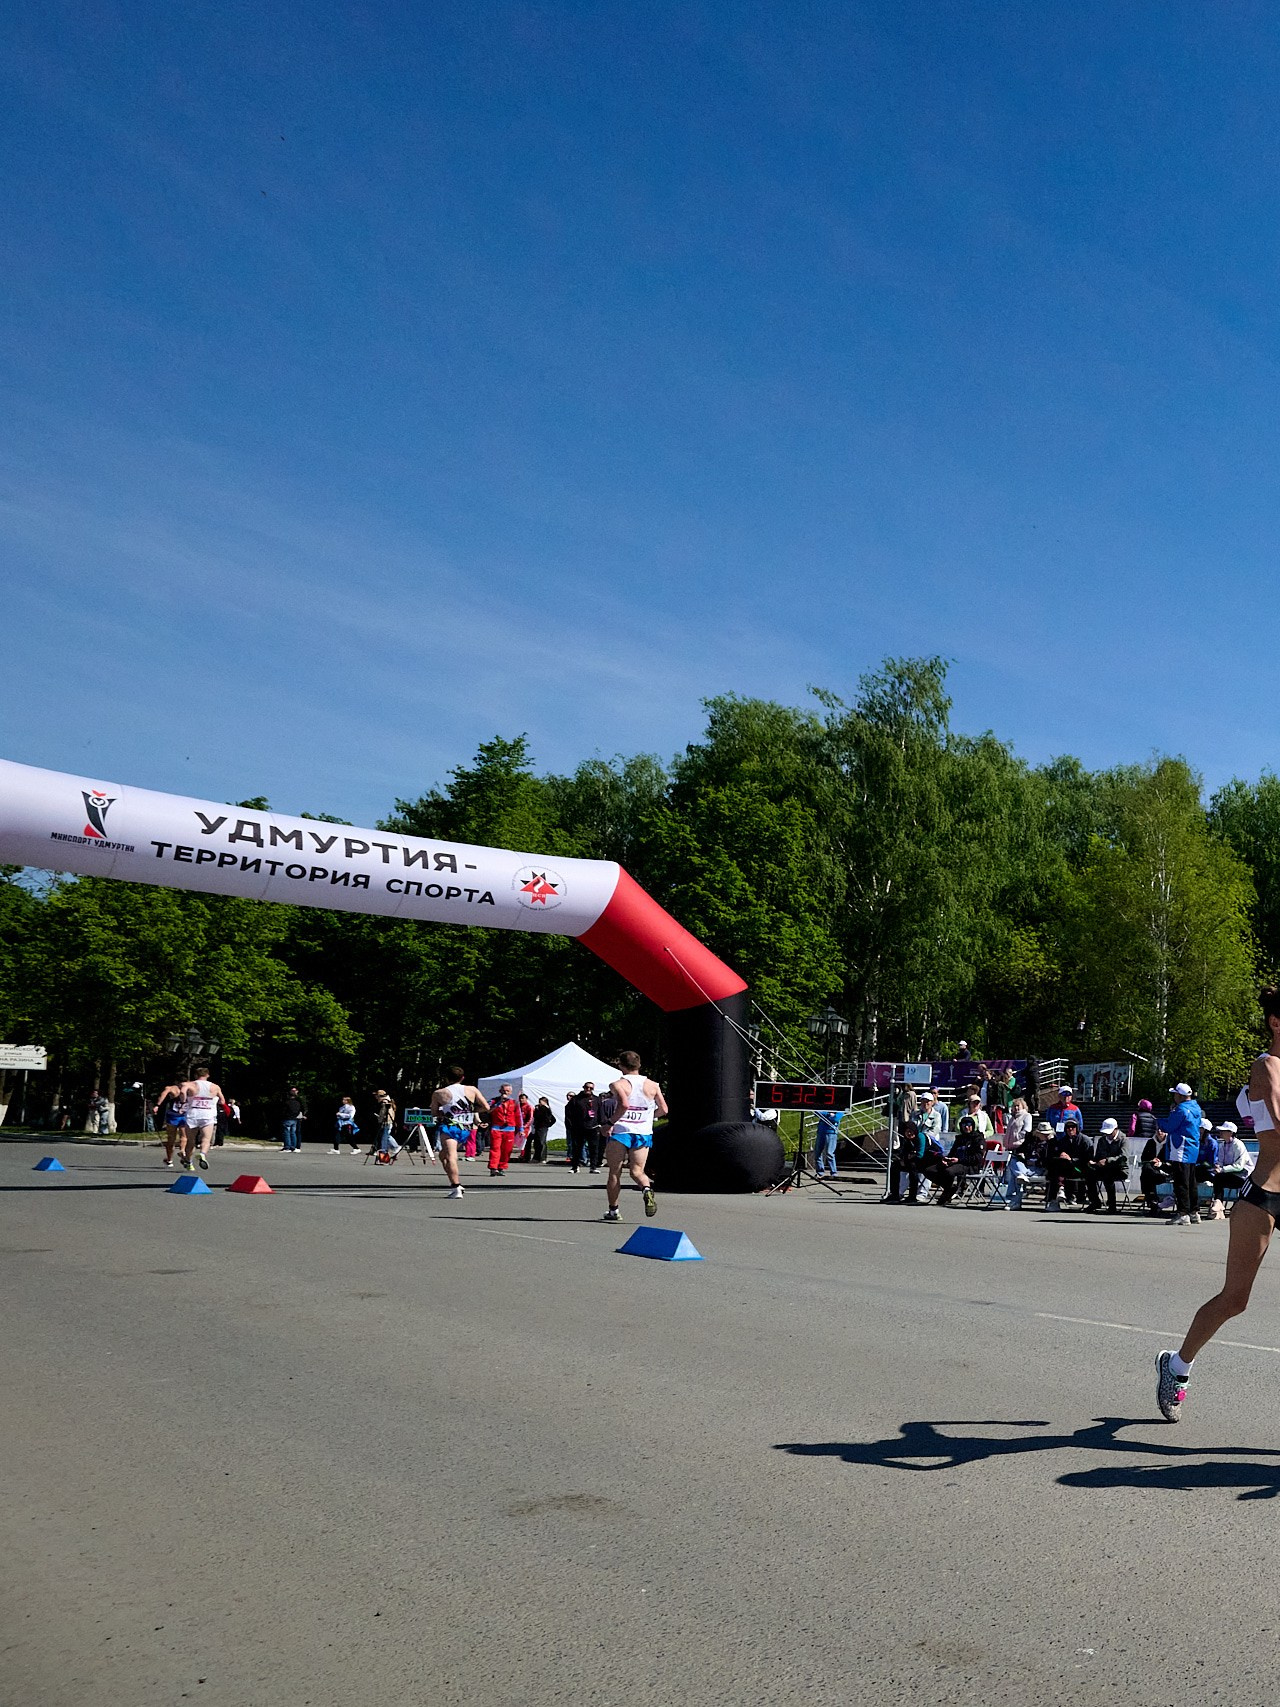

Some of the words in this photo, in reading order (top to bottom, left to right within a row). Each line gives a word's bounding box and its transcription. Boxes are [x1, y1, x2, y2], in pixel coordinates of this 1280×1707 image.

[50, 831, 92, 846] МИНСПОРТ
[94, 839, 135, 853] УДМУРТИИ
[150, 840, 371, 890] ТЕРРИТОРИЯ
[386, 878, 496, 906] СПОРТА
[626, 1111, 643, 1121] 107
